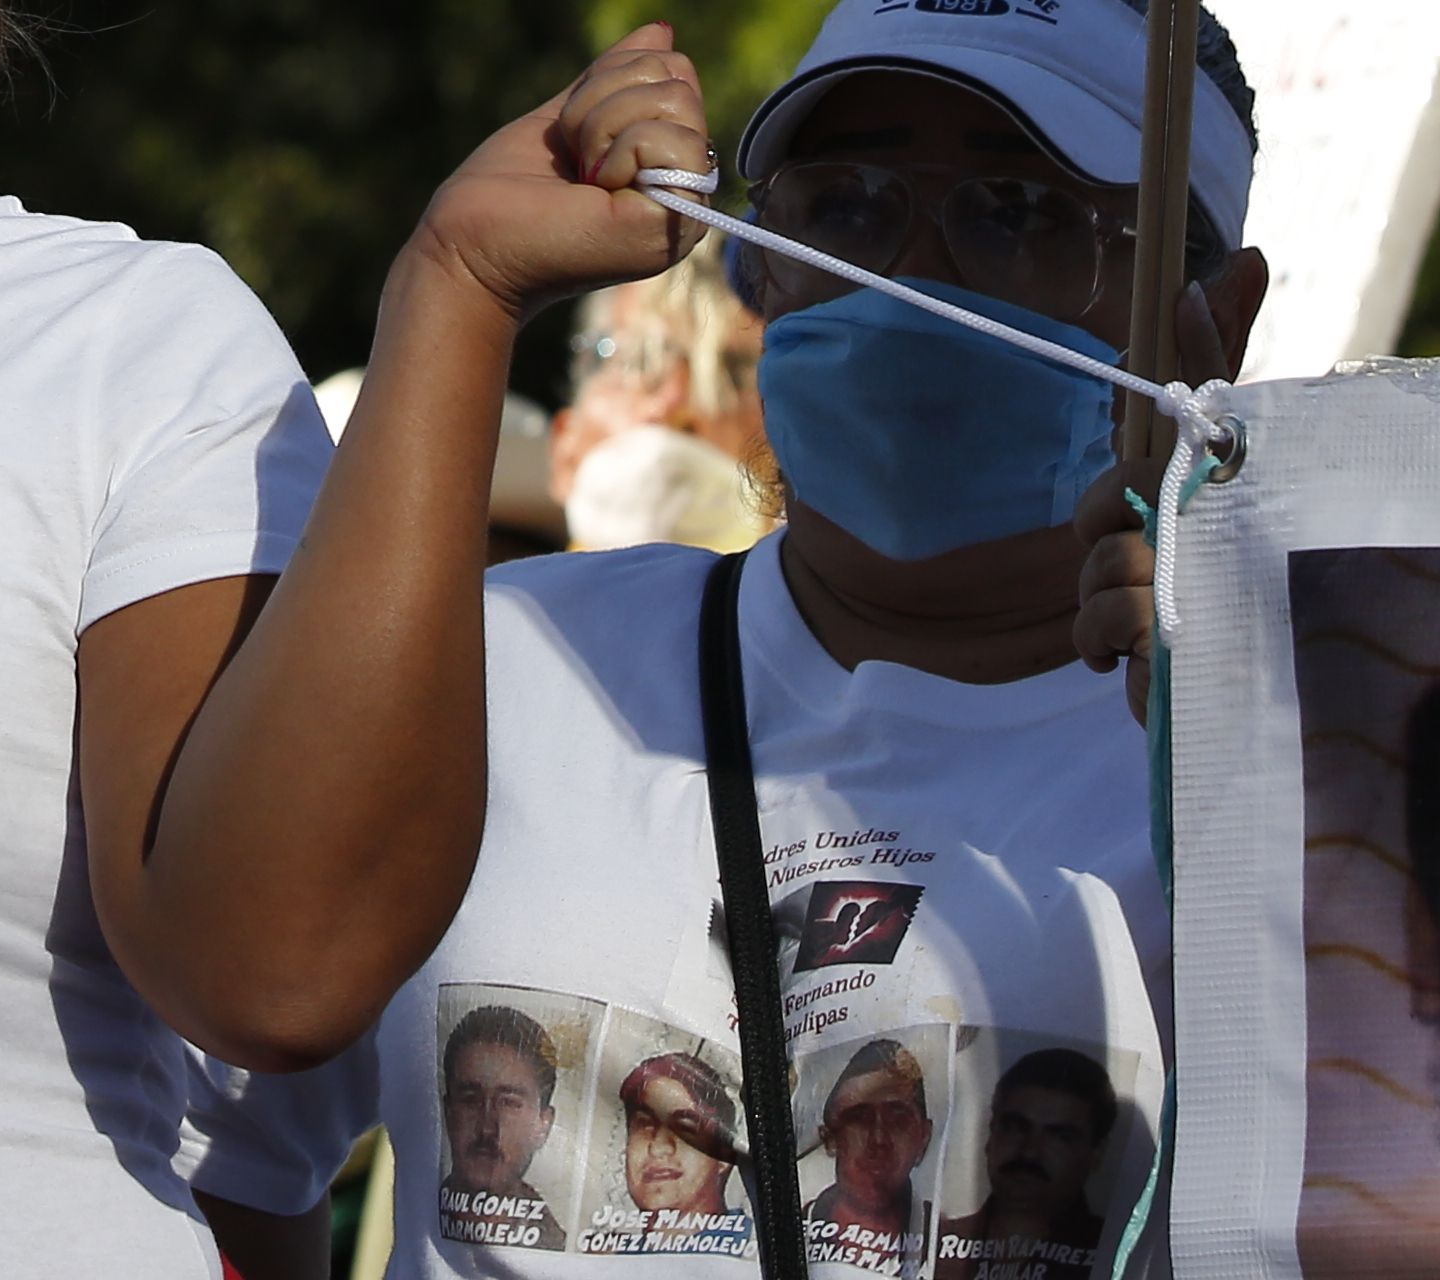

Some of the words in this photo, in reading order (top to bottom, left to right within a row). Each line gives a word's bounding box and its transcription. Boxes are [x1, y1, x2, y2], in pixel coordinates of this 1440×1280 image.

[814, 828, 901, 849] Unidas
[768, 852, 866, 889] Nuestros
[869, 848, 937, 866] Hijos
[783, 969, 877, 1017] Fernando
[440, 1187, 470, 1212] RAUL
[471, 1191, 547, 1221] GOMEZ
[591, 1204, 652, 1228] JOSE
[655, 1208, 746, 1233] MANUEL
[441, 1214, 541, 1247] MARMOLEJO
[576, 1231, 641, 1253] GOMEZ
[642, 1232, 758, 1258] MARMOLEJO
